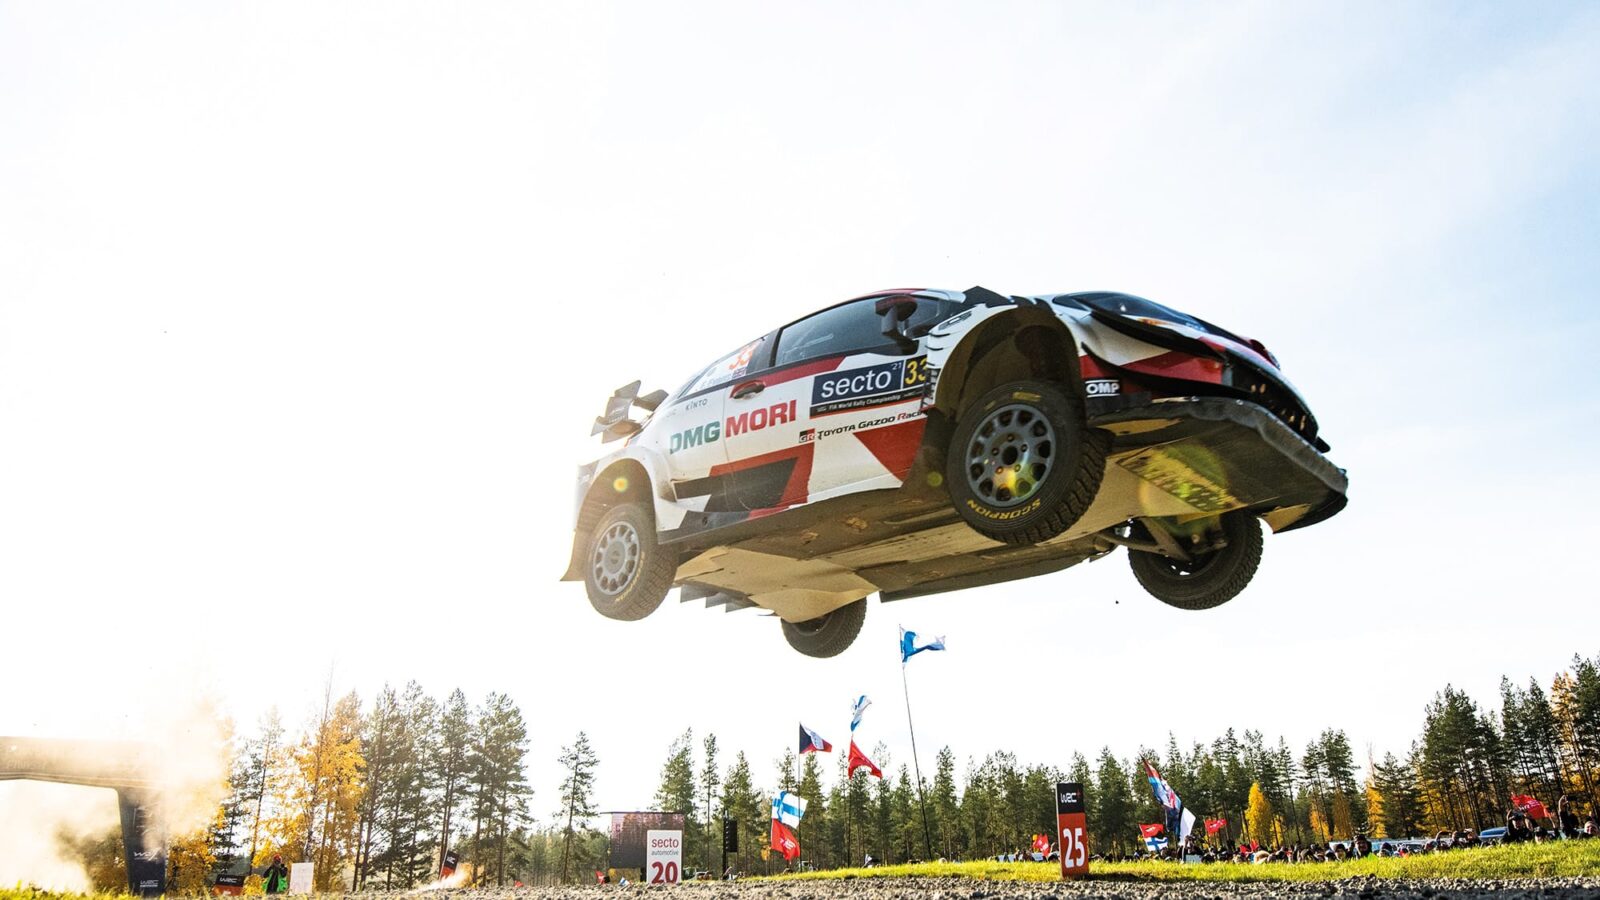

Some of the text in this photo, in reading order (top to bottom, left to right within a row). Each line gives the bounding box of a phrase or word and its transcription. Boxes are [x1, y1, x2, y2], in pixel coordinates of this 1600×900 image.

[820, 370, 892, 398] secto
[905, 358, 927, 385] 33
[1086, 382, 1120, 394] OMP
[838, 401, 853, 409] World
[853, 398, 866, 407] Rally
[866, 394, 901, 405] Championship
[669, 399, 797, 454] DMG MORI
[799, 433, 815, 444] GR
[817, 424, 856, 441] TOYOTA
[858, 415, 896, 430] GAZOO
[966, 498, 1042, 520] SCORPION
[651, 838, 679, 848] secto
[1063, 827, 1085, 868] 25
[651, 861, 679, 884] 20
